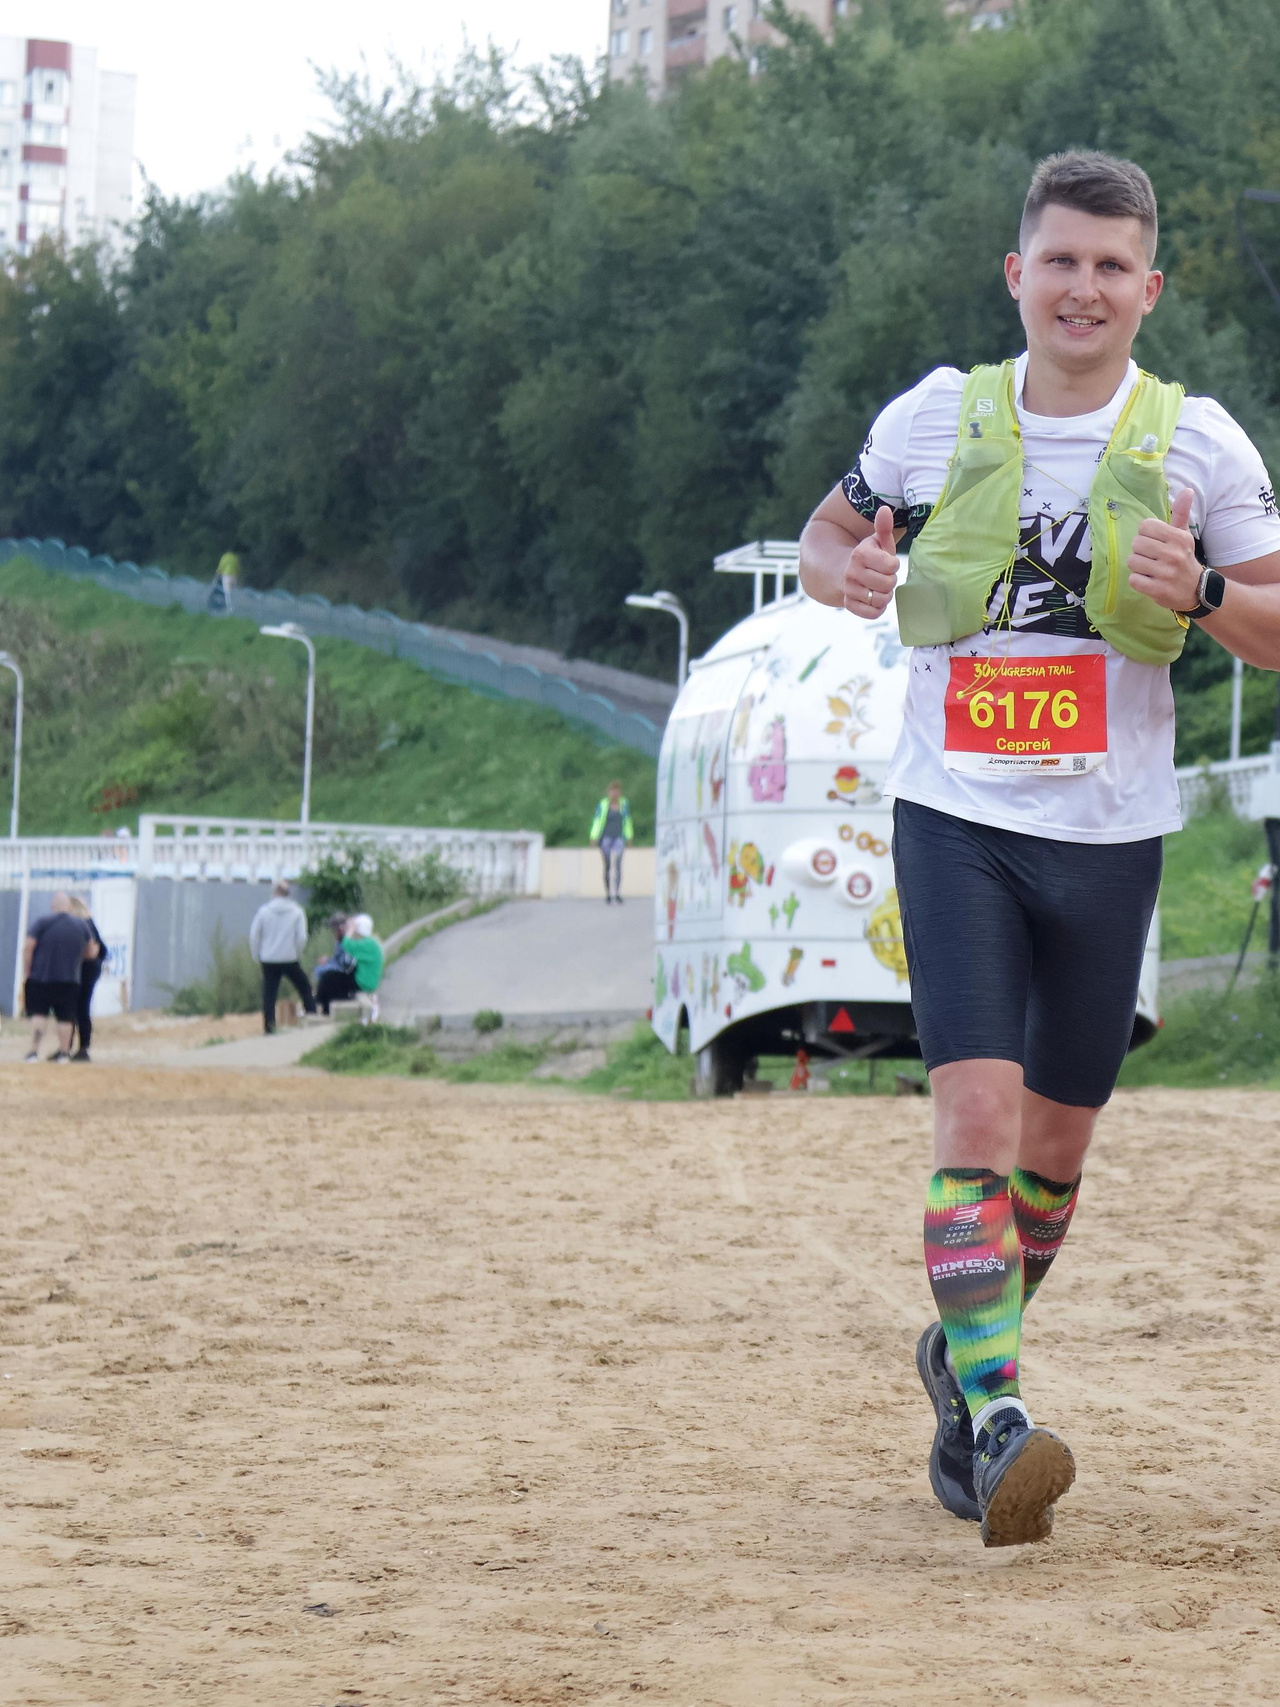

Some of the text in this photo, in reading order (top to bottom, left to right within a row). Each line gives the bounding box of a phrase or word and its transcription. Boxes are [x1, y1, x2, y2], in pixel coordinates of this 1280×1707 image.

[1001, 665, 1046, 677] UGRESHA
[1048, 665, 1075, 676] TRAIL
[969, 689, 1079, 730] 6176
[996, 737, 1051, 753] Сергей
[1040, 758, 1060, 766] PRO
[960, 1268, 992, 1276] TRAIL
